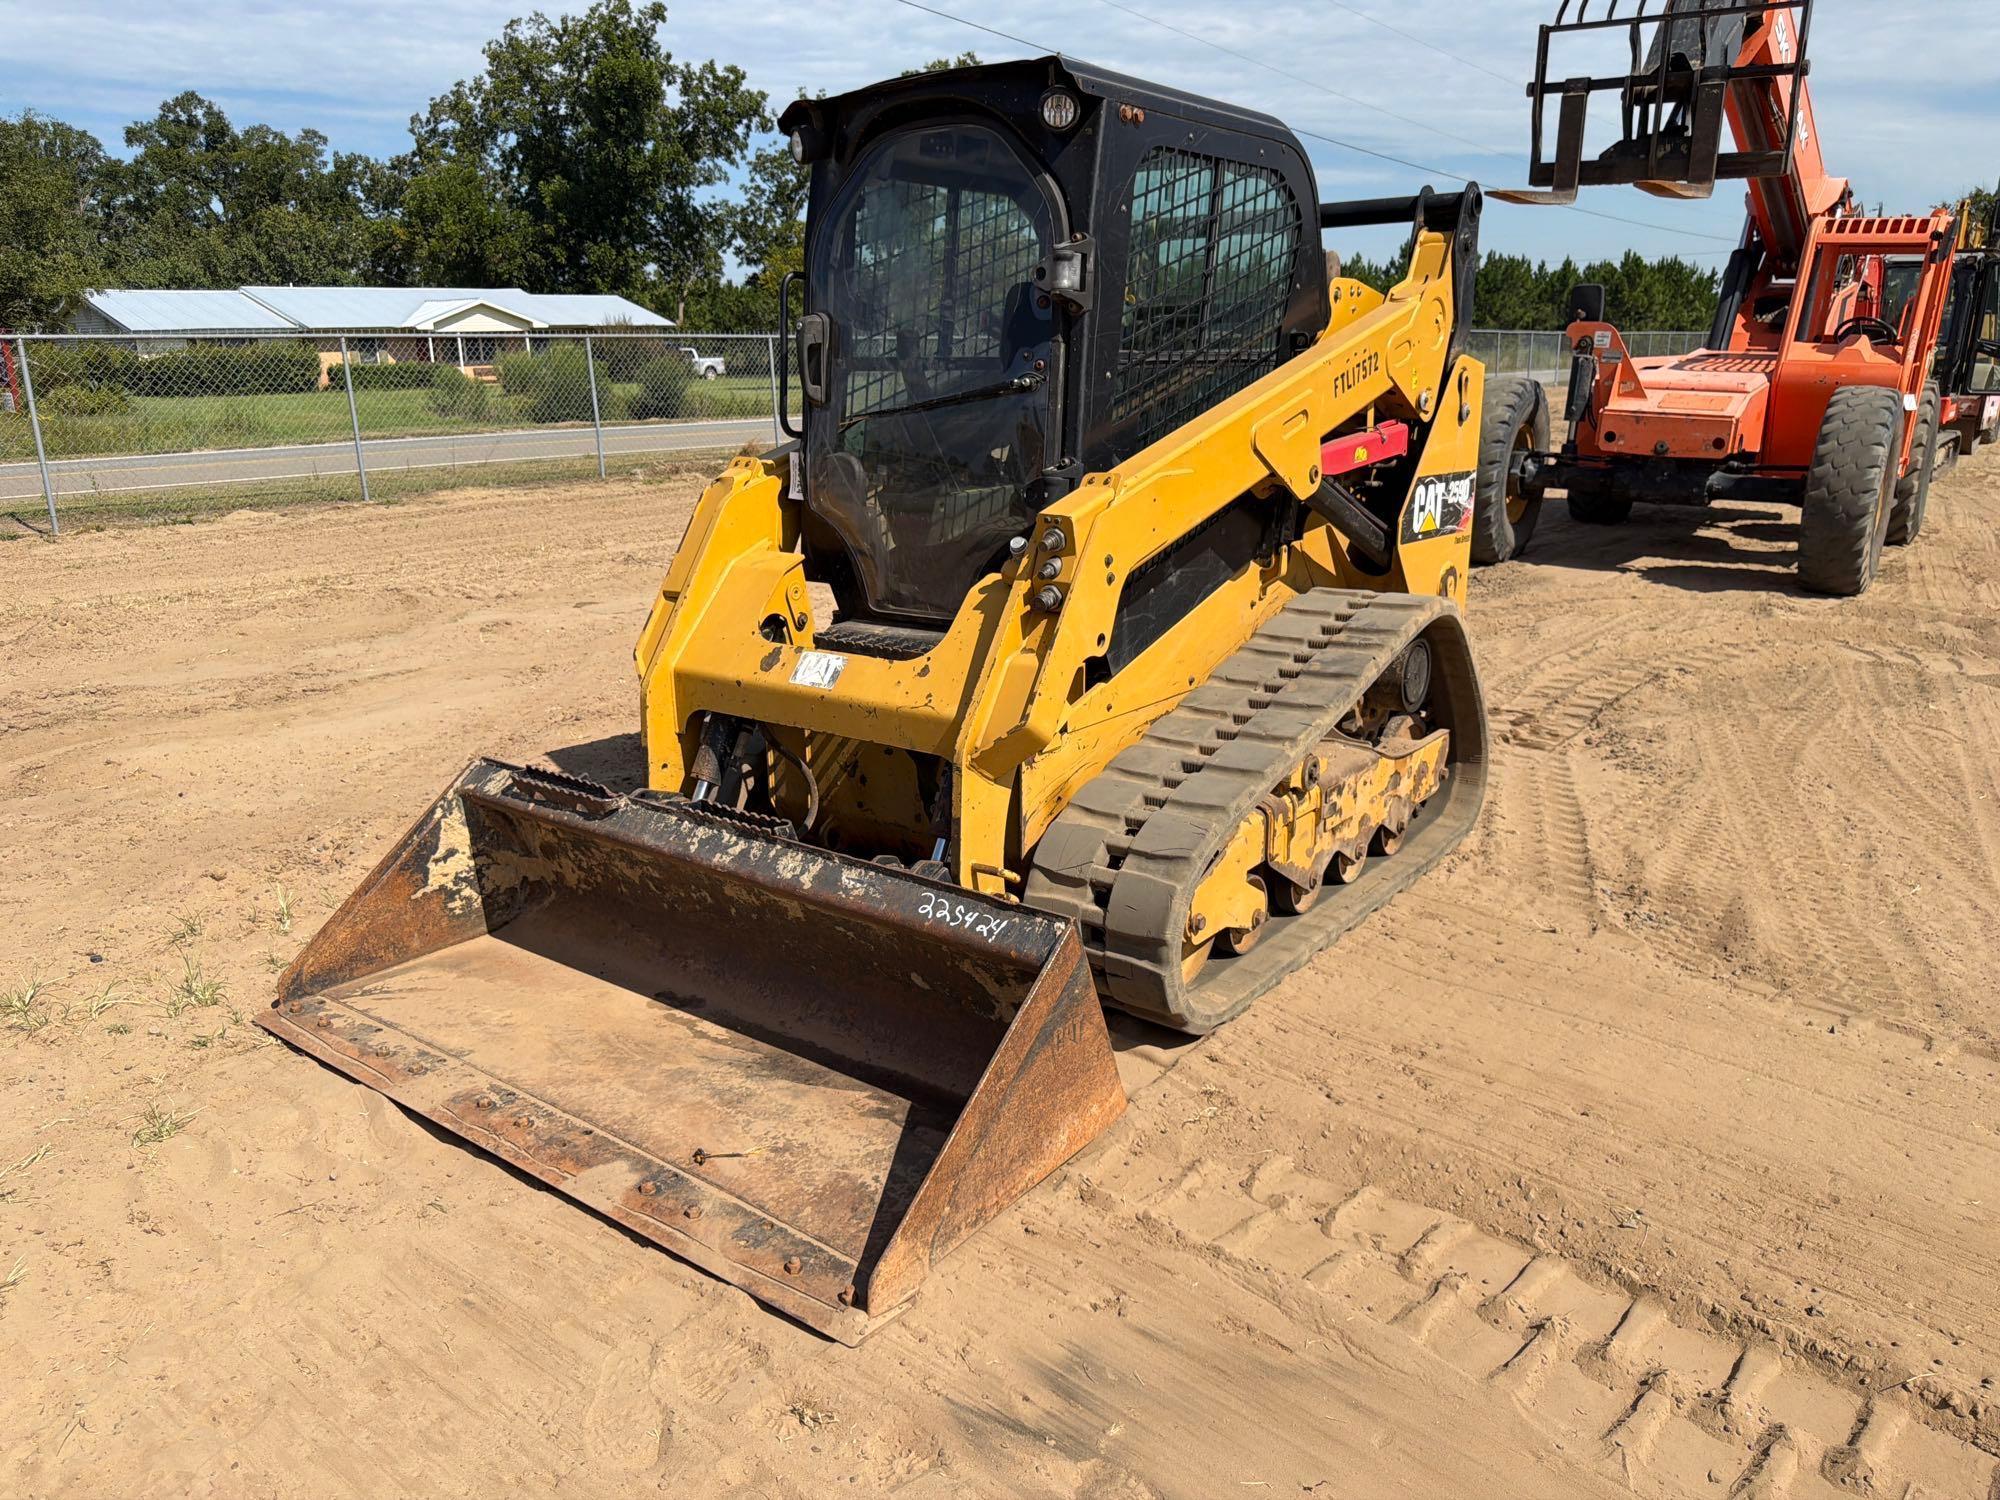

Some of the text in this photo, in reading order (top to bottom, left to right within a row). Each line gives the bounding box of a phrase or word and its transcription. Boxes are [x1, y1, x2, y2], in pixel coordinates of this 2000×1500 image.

[1334, 351, 1379, 399] FTL17572
[1413, 479, 1471, 534] CAT 259D
[918, 892, 1009, 943] 225424
